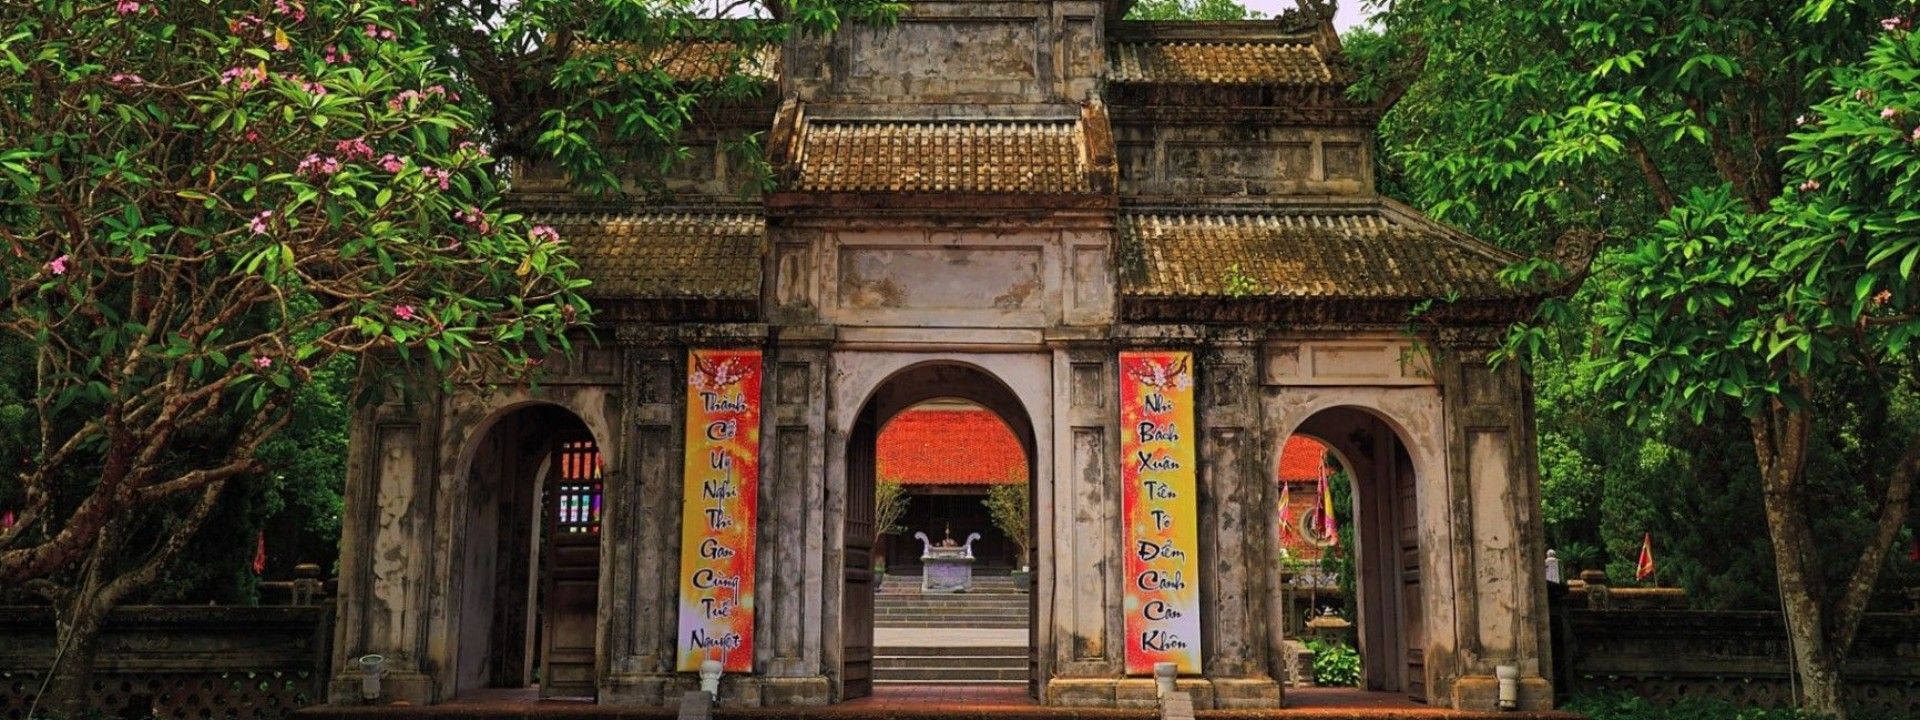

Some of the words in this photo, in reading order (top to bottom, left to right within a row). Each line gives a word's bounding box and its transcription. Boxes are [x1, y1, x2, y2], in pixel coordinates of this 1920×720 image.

[700, 391, 747, 412] Thành
[707, 420, 736, 440] Cổ
[1139, 422, 1179, 443] Bách
[711, 451, 731, 482] Uy
[1139, 451, 1180, 472] Xuân
[703, 480, 737, 510] Nghi
[1152, 510, 1170, 530] Tô
[701, 538, 733, 559] Gan
[1138, 539, 1185, 563] Điểm
[693, 569, 739, 605] Cùng
[1142, 630, 1187, 651] Khôn
